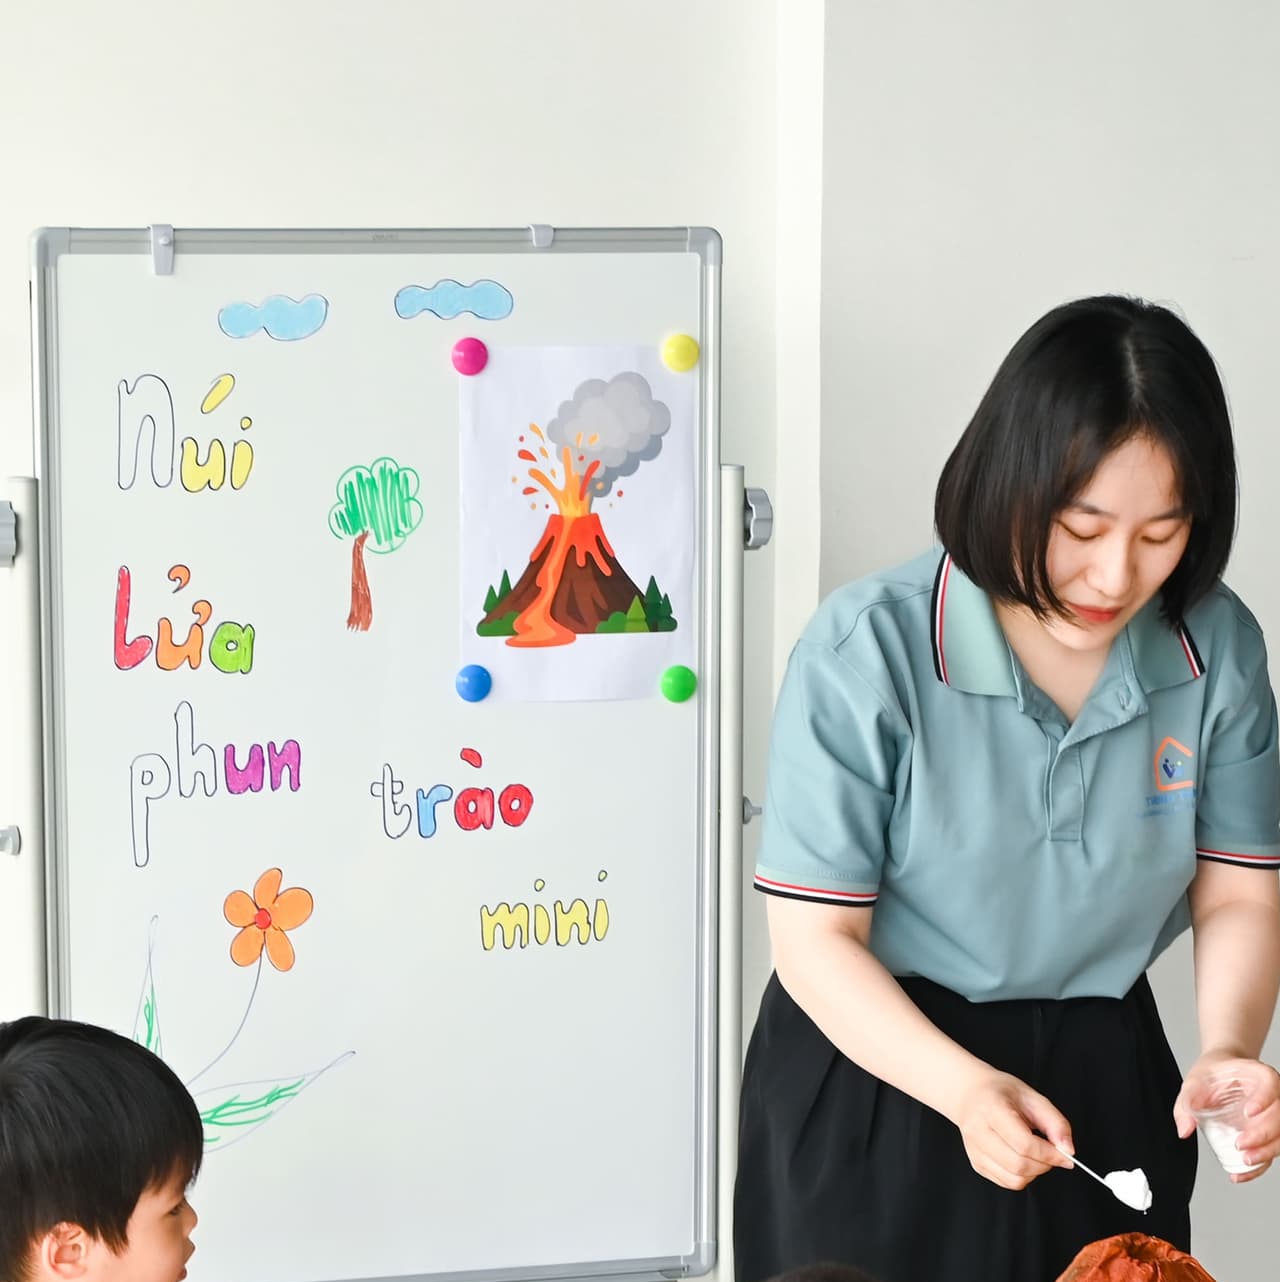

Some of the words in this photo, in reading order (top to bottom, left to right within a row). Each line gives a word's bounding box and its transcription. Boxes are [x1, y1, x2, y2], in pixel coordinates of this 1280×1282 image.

[117, 372, 255, 493] Núi
[129, 700, 303, 868] phun
[370, 747, 535, 840] trào
[479, 869, 610, 952] mini
